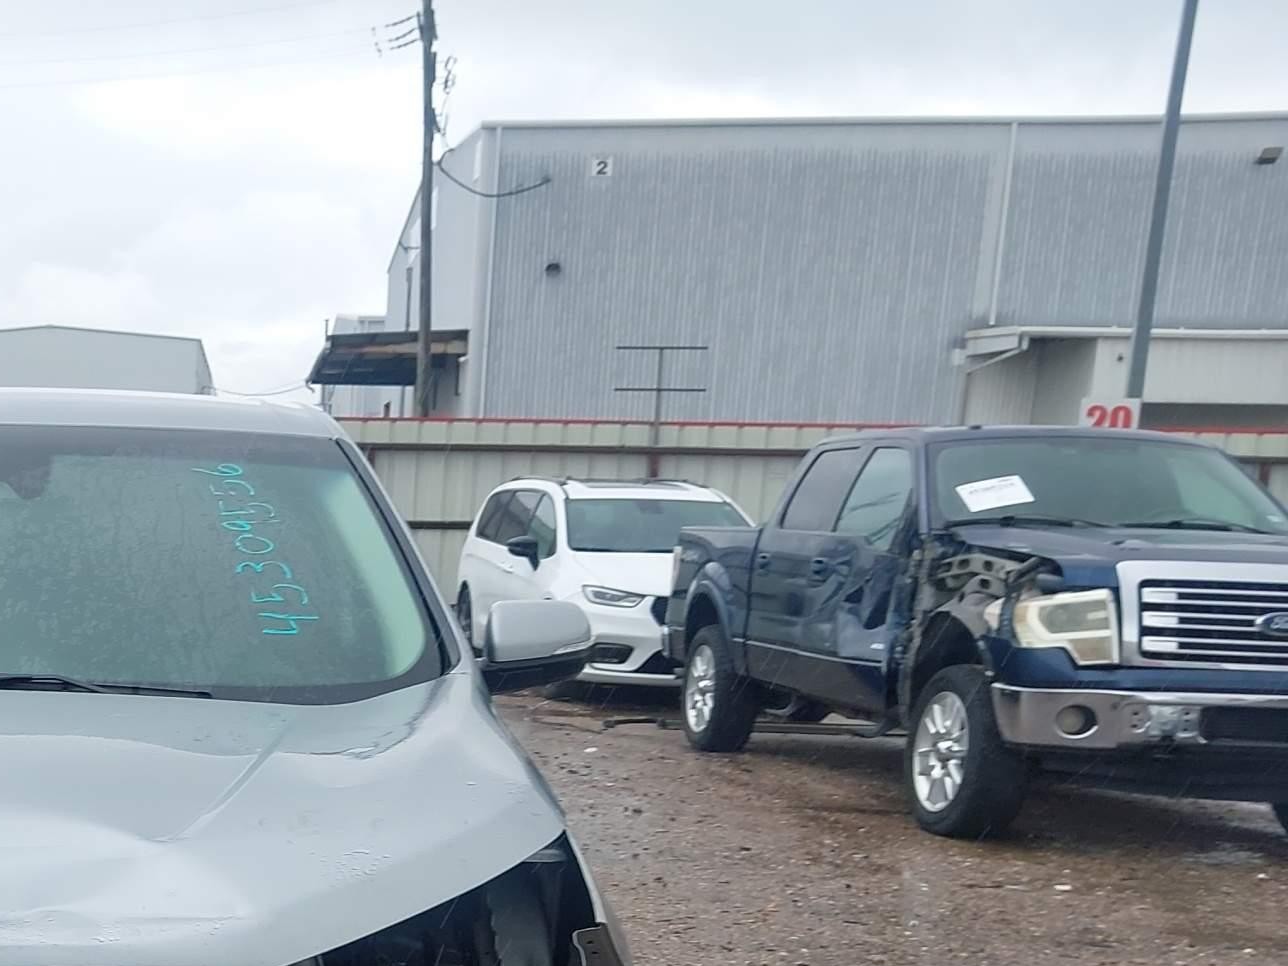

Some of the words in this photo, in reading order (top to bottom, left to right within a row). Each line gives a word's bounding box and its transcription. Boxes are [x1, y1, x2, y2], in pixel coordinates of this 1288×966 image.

[596, 160, 608, 176] 2
[1086, 404, 1133, 429] 20
[191, 463, 320, 635] 45309556
